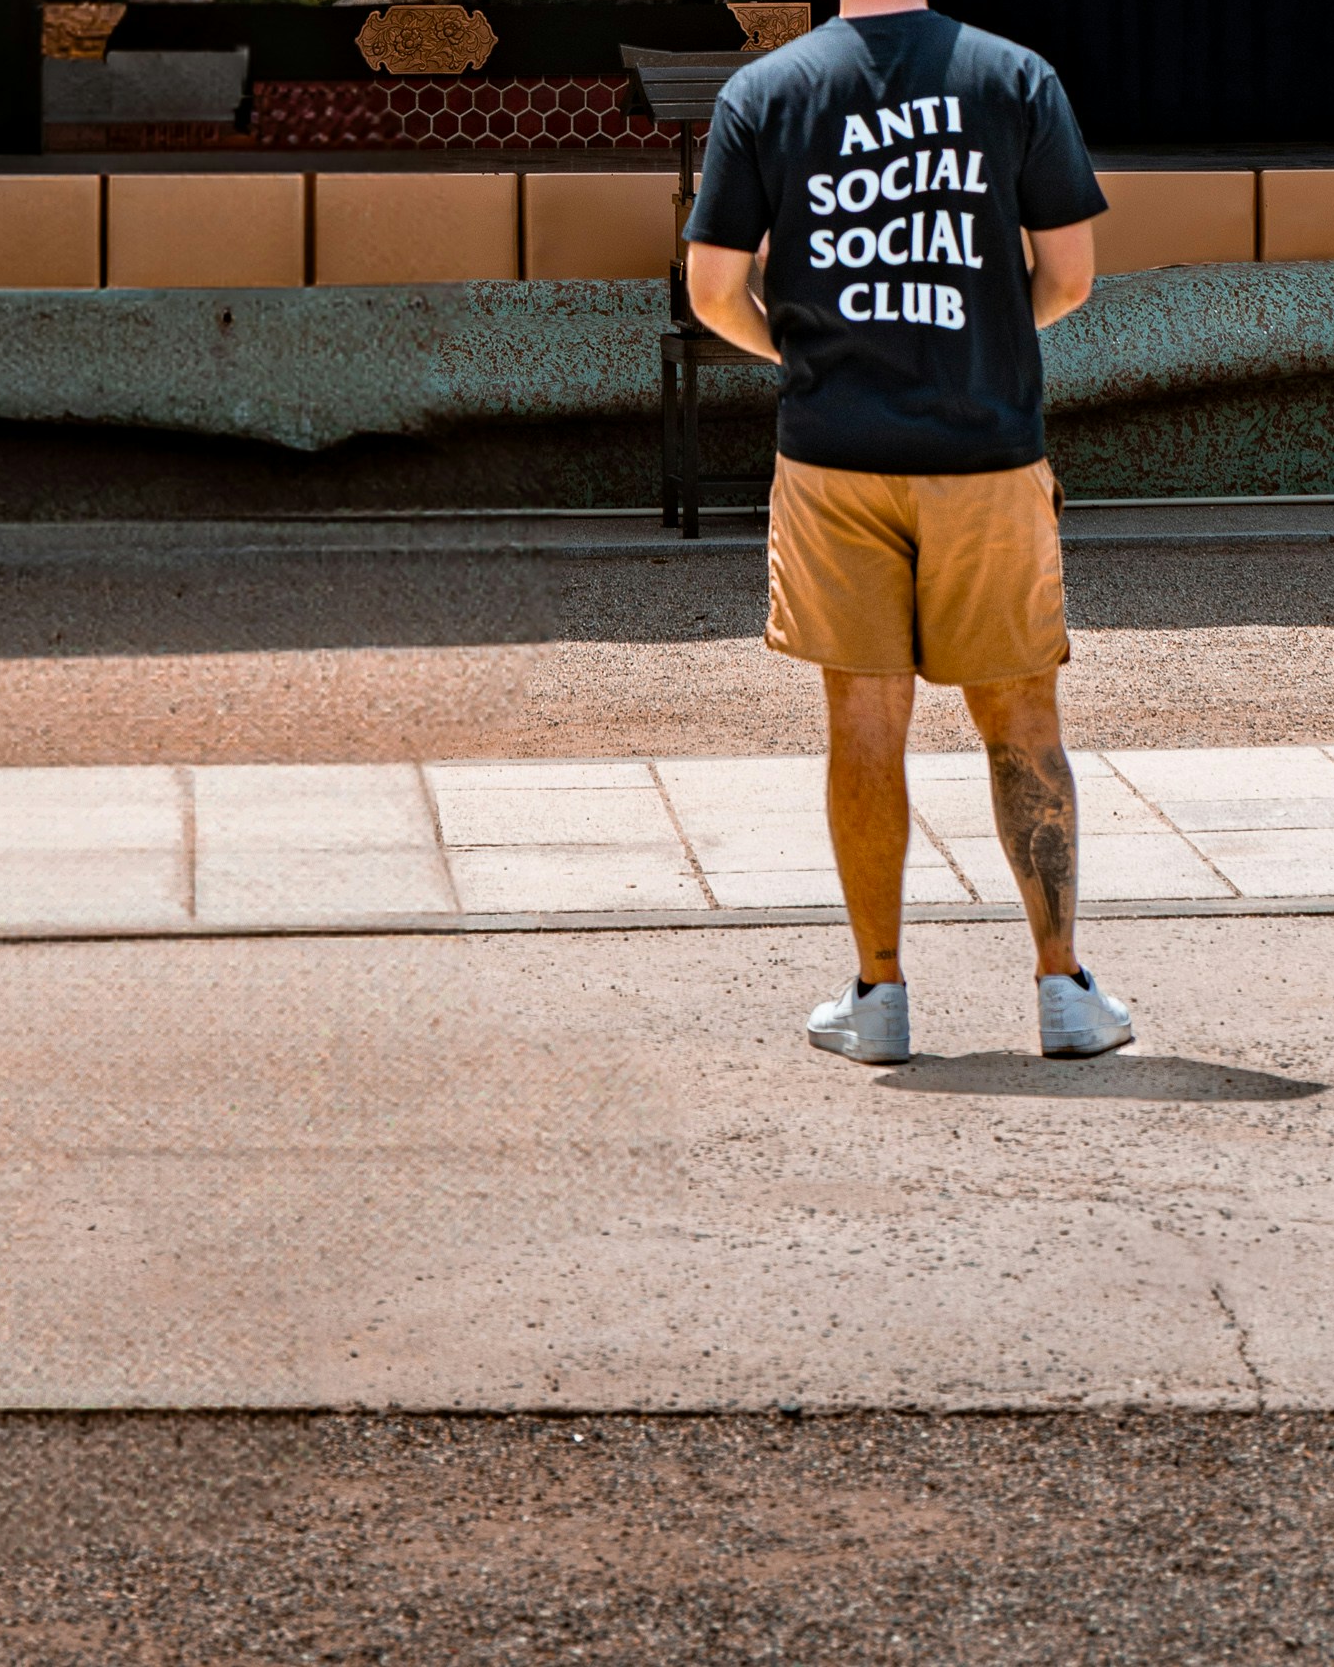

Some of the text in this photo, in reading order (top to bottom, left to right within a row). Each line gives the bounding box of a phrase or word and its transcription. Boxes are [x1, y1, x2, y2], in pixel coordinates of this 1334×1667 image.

[839, 96, 963, 157] ANTI
[807, 148, 988, 216] SOCIAL
[809, 209, 984, 269] SOCIAL
[838, 282, 966, 331] CLUB
